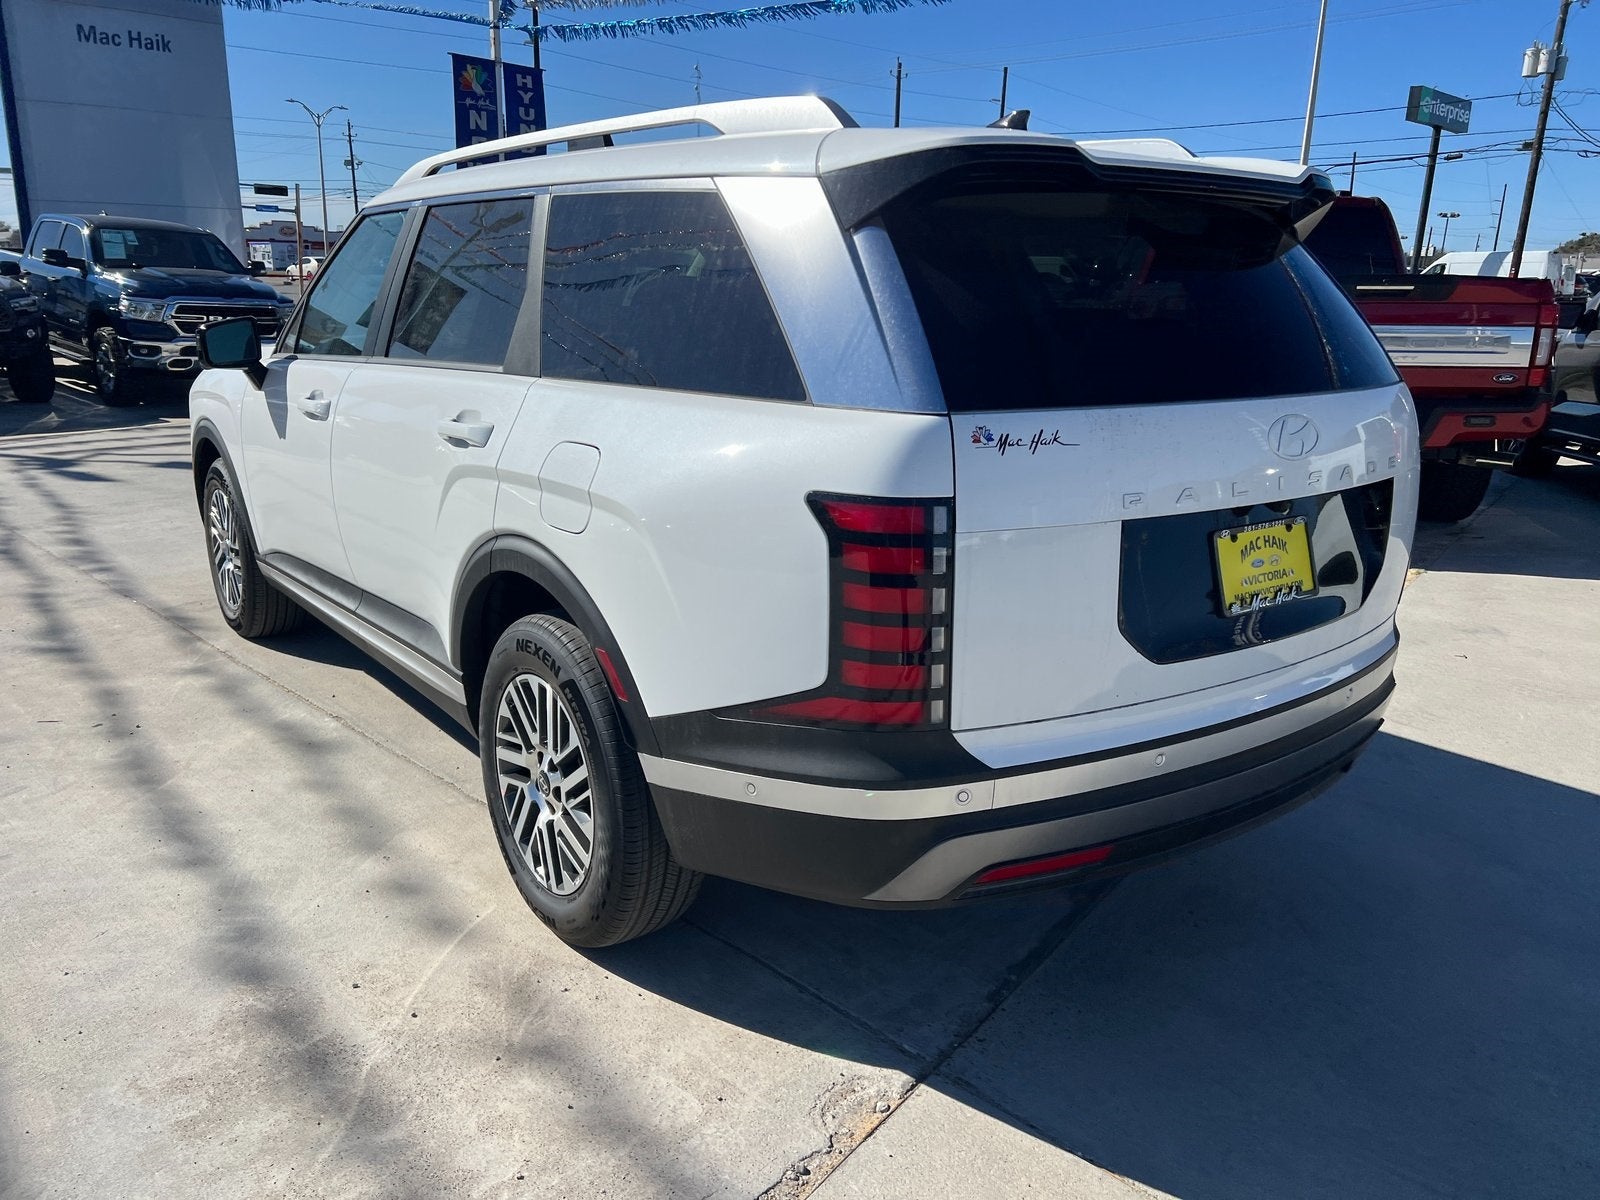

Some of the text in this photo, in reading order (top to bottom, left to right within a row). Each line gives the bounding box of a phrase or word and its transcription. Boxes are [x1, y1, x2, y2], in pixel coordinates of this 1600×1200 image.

[76, 23, 172, 53] Mac Haik
[1420, 96, 1470, 123] enterprise
[994, 428, 1080, 456] Mac Haik
[1122, 456, 1396, 509] PALISADE
[1240, 536, 1262, 563] MAC
[1263, 534, 1289, 554] HAIK
[1247, 568, 1289, 586] VICTORIA
[1250, 585, 1303, 611] Mac Haik
[515, 638, 562, 680] NEXEN
